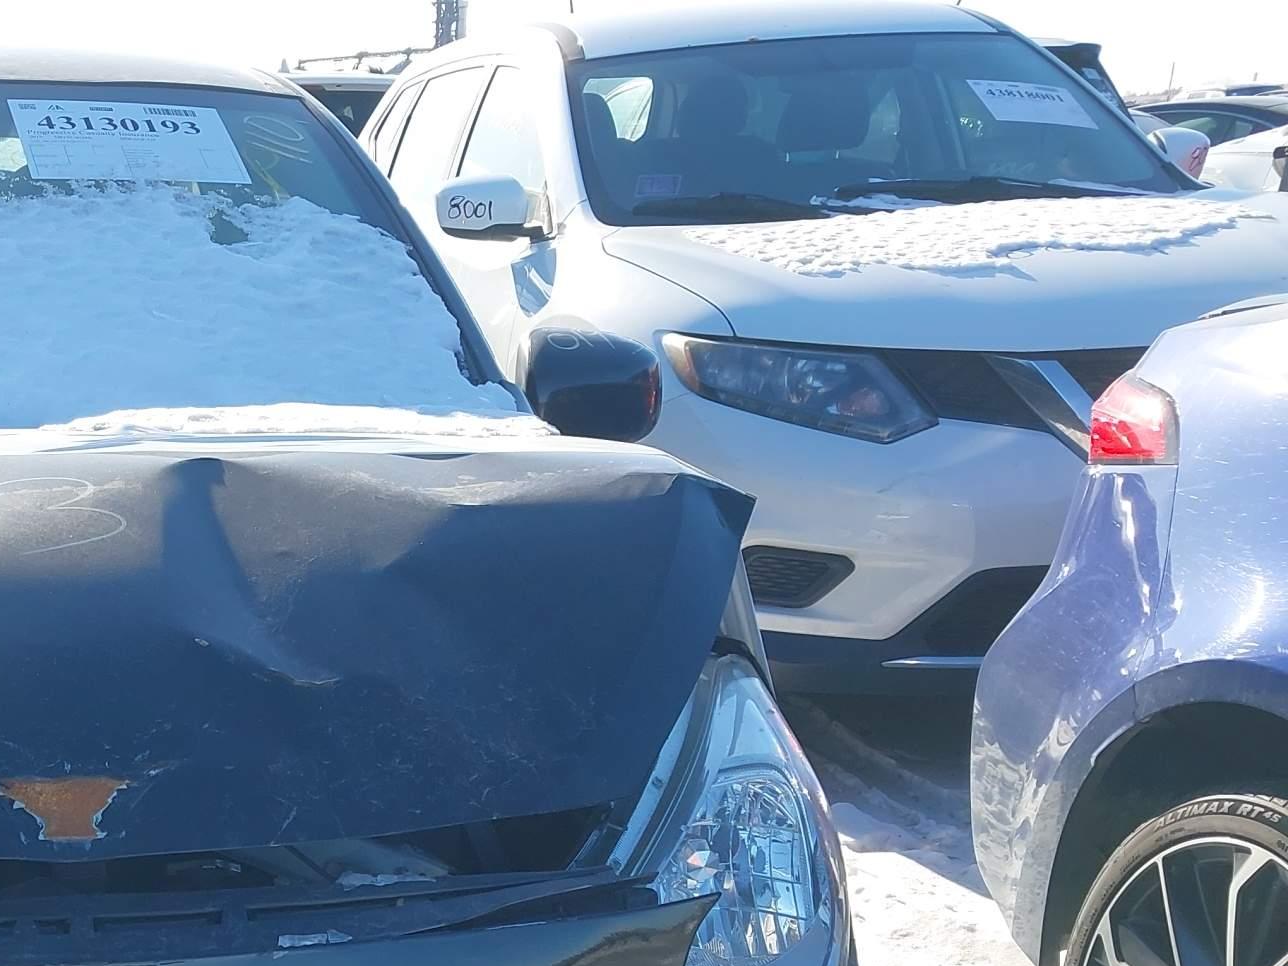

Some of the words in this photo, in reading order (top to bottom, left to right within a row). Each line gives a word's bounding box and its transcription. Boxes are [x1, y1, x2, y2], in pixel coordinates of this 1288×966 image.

[37, 114, 201, 135] 43130193
[448, 195, 493, 221] 8001
[1153, 801, 1236, 832] ALTIMAX
